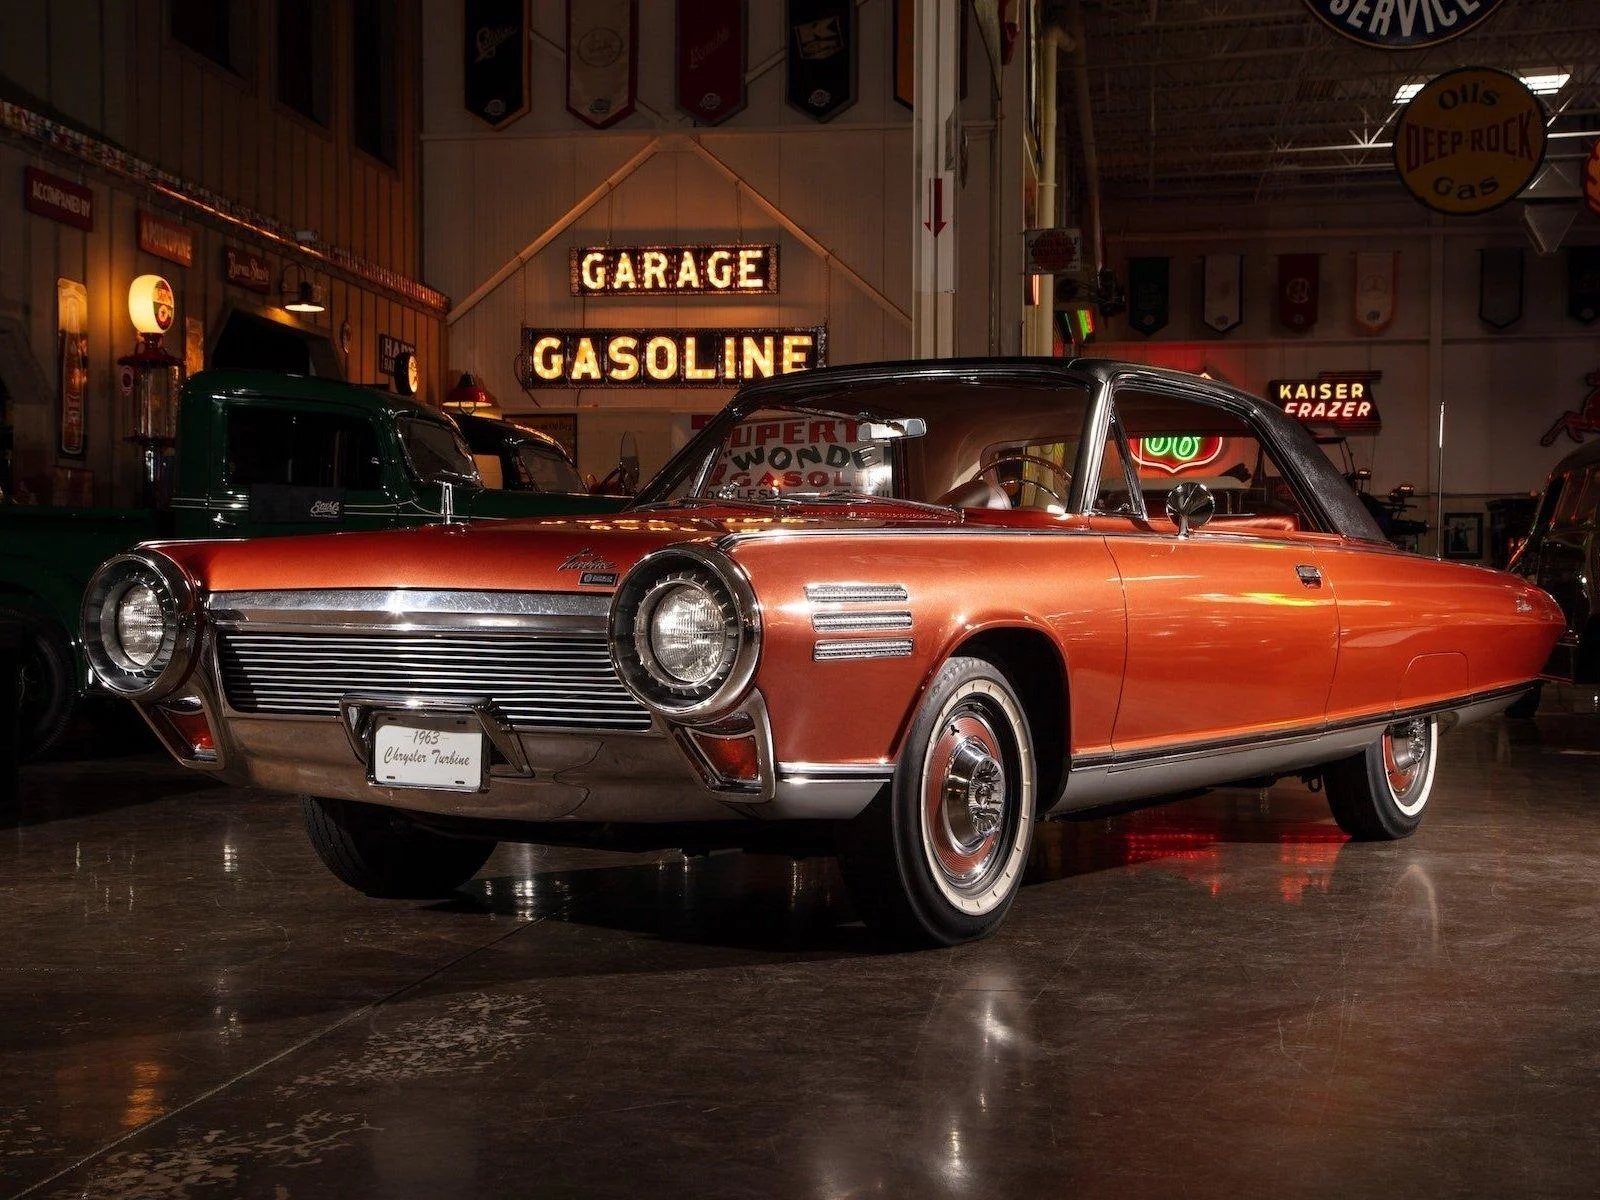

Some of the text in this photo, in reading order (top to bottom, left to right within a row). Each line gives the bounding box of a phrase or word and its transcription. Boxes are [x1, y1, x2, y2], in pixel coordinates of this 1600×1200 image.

[1406, 107, 1535, 173] DEEP ROCK
[1432, 175, 1499, 201] Gas
[581, 250, 763, 290] GARAGE
[532, 335, 813, 380] GASOLINE
[1280, 383, 1364, 400] KAISER
[1284, 401, 1371, 417] FRAZER
[412, 730, 440, 745] 1963
[383, 746, 470, 766] Chrysler Turbine
